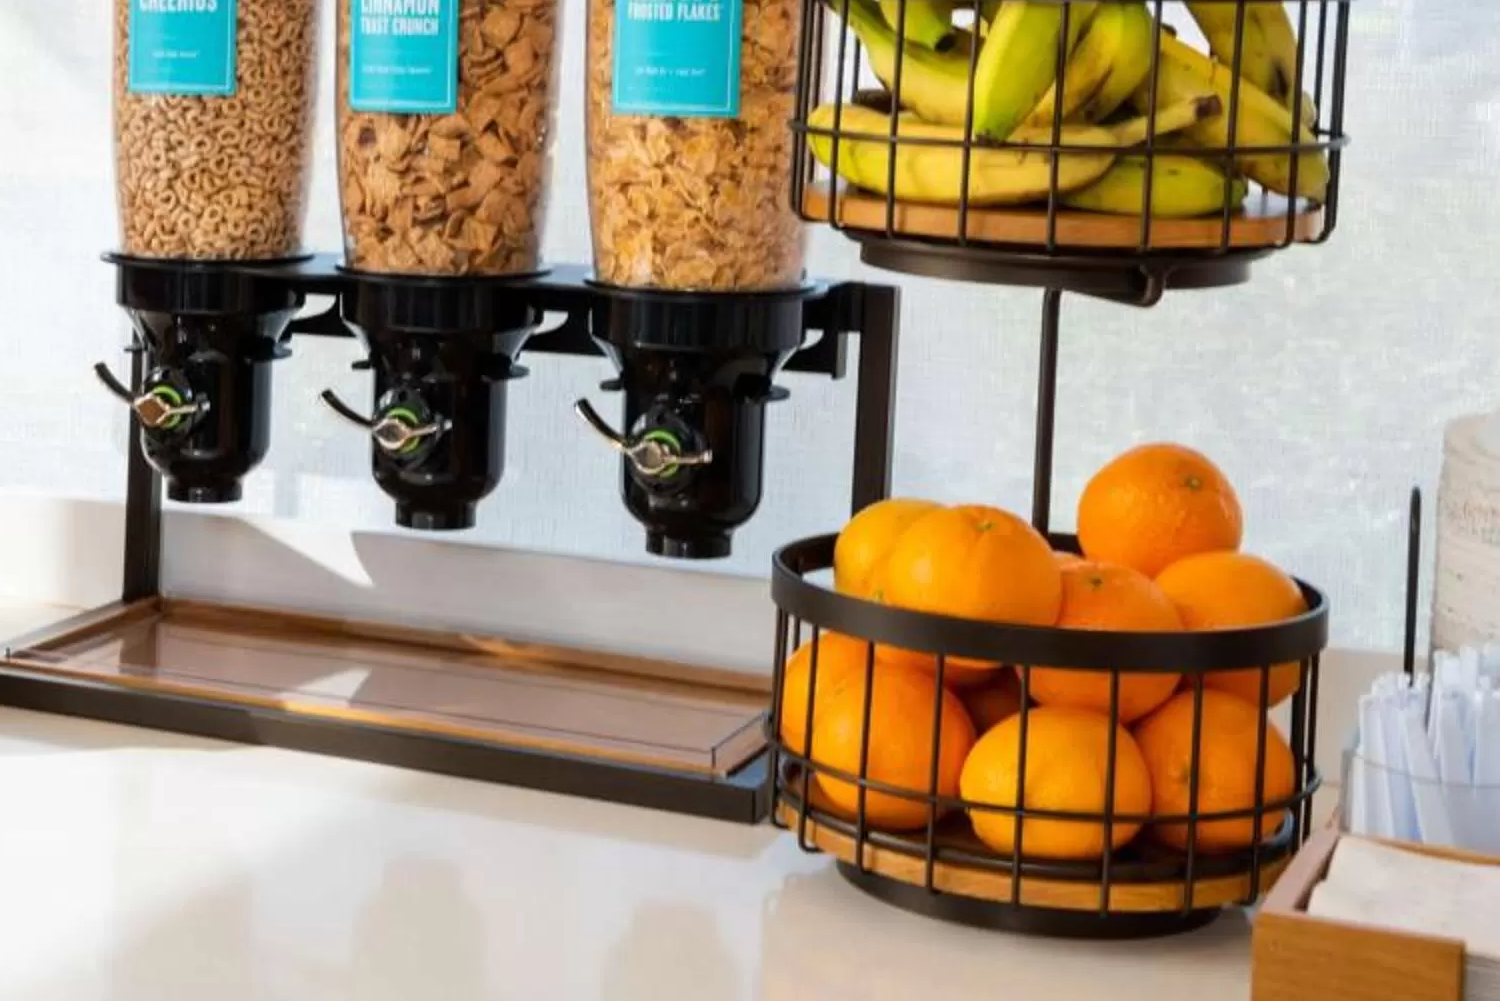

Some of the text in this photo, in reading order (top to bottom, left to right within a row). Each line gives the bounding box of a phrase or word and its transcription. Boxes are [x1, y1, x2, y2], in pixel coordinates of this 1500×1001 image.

[628, 2, 720, 22] FROSTED FLAKES
[392, 16, 439, 36] CRUNCH
